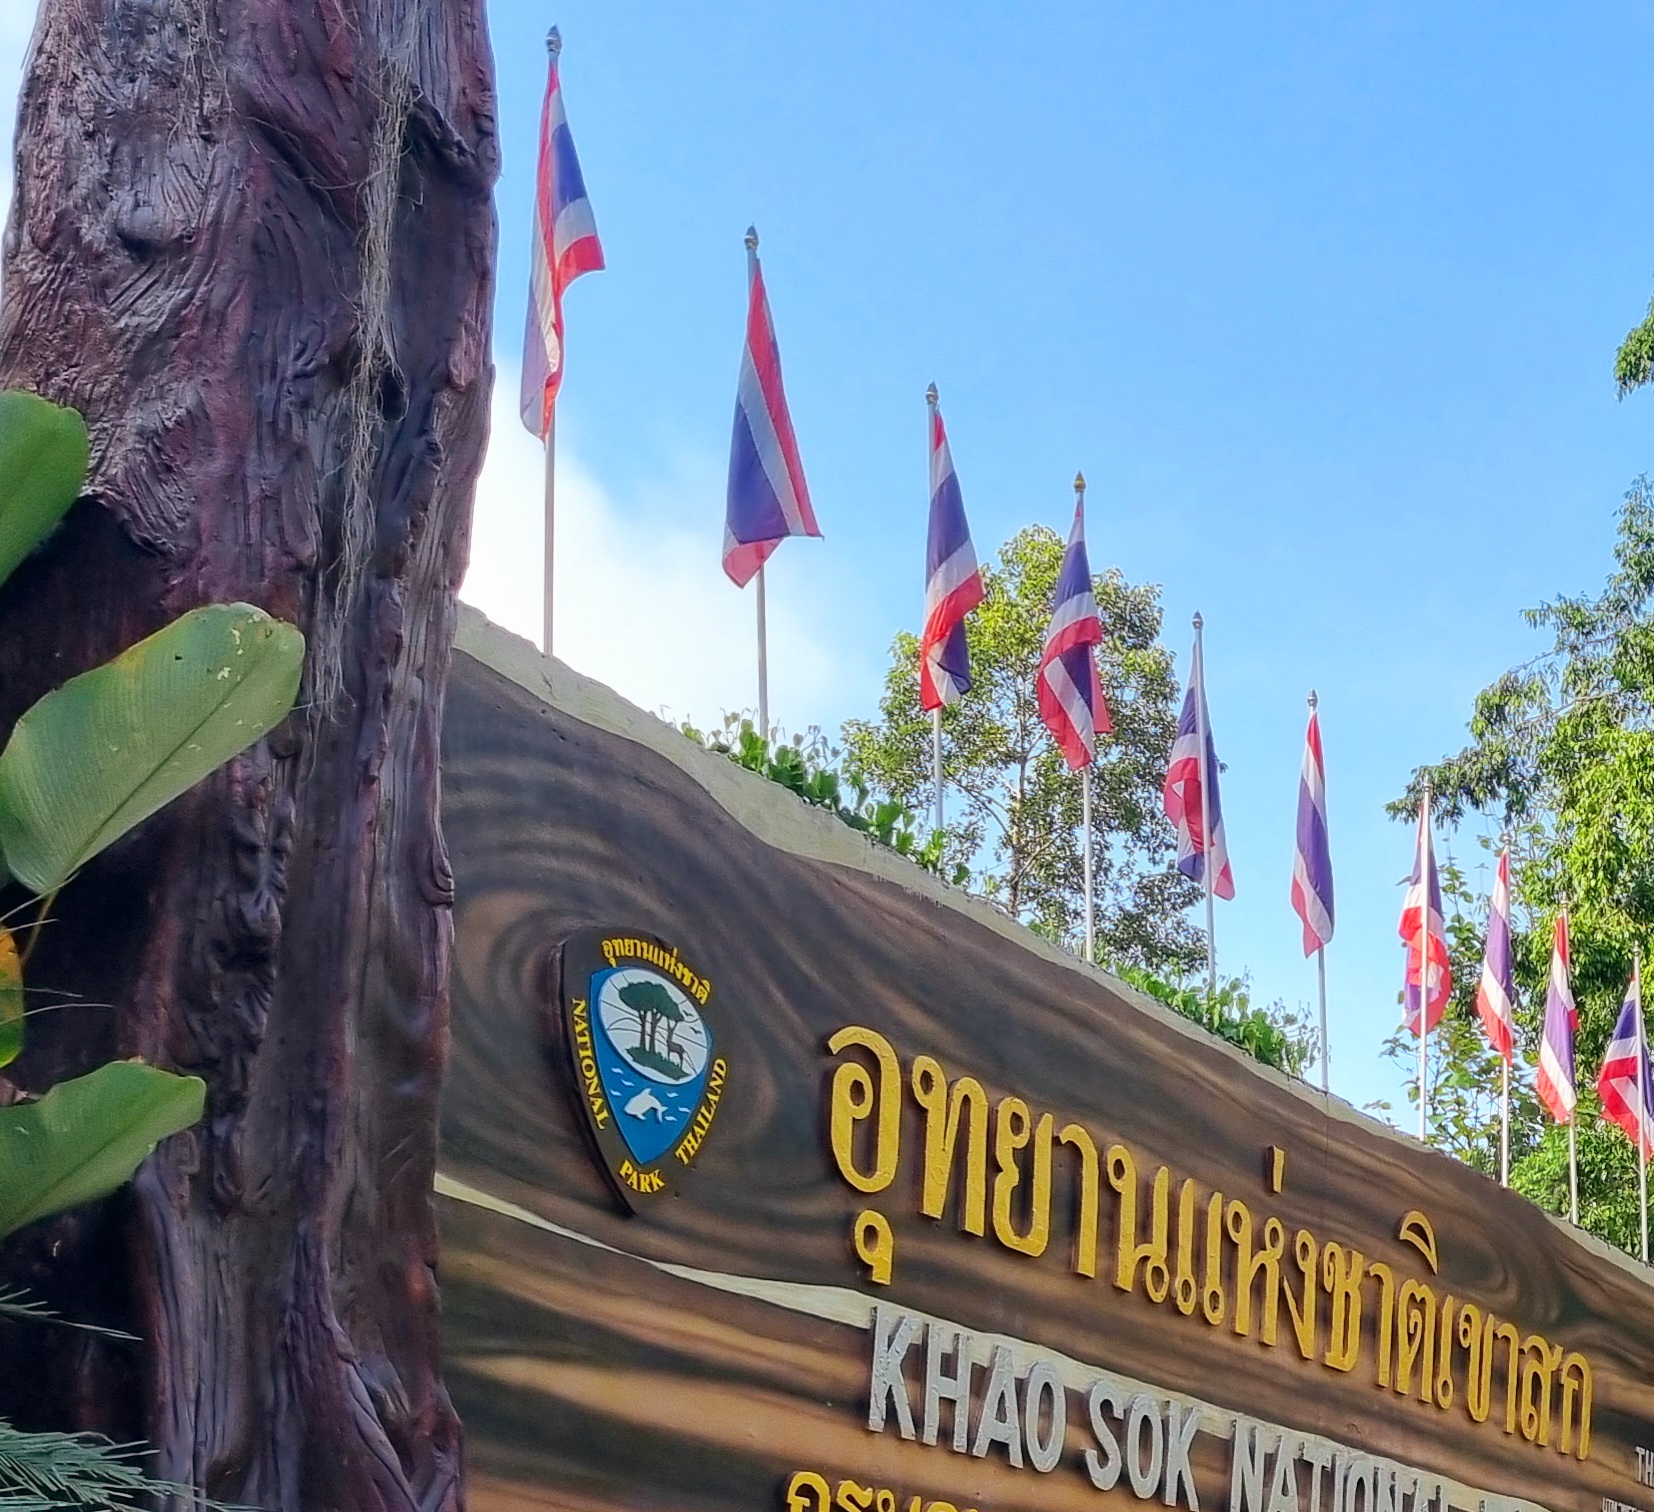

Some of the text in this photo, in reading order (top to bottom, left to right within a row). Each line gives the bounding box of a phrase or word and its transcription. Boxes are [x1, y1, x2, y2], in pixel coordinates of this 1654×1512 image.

[600, 938, 712, 1005] อุทยานแห่งชาติ
[571, 997, 606, 1130] NATIONAL
[674, 1057, 728, 1166] THAILAND
[618, 1159, 666, 1193] PARK
[827, 1024, 1592, 1462] อุทยานแห่งชาติเขาสก
[867, 1305, 1067, 1474] KHAO
